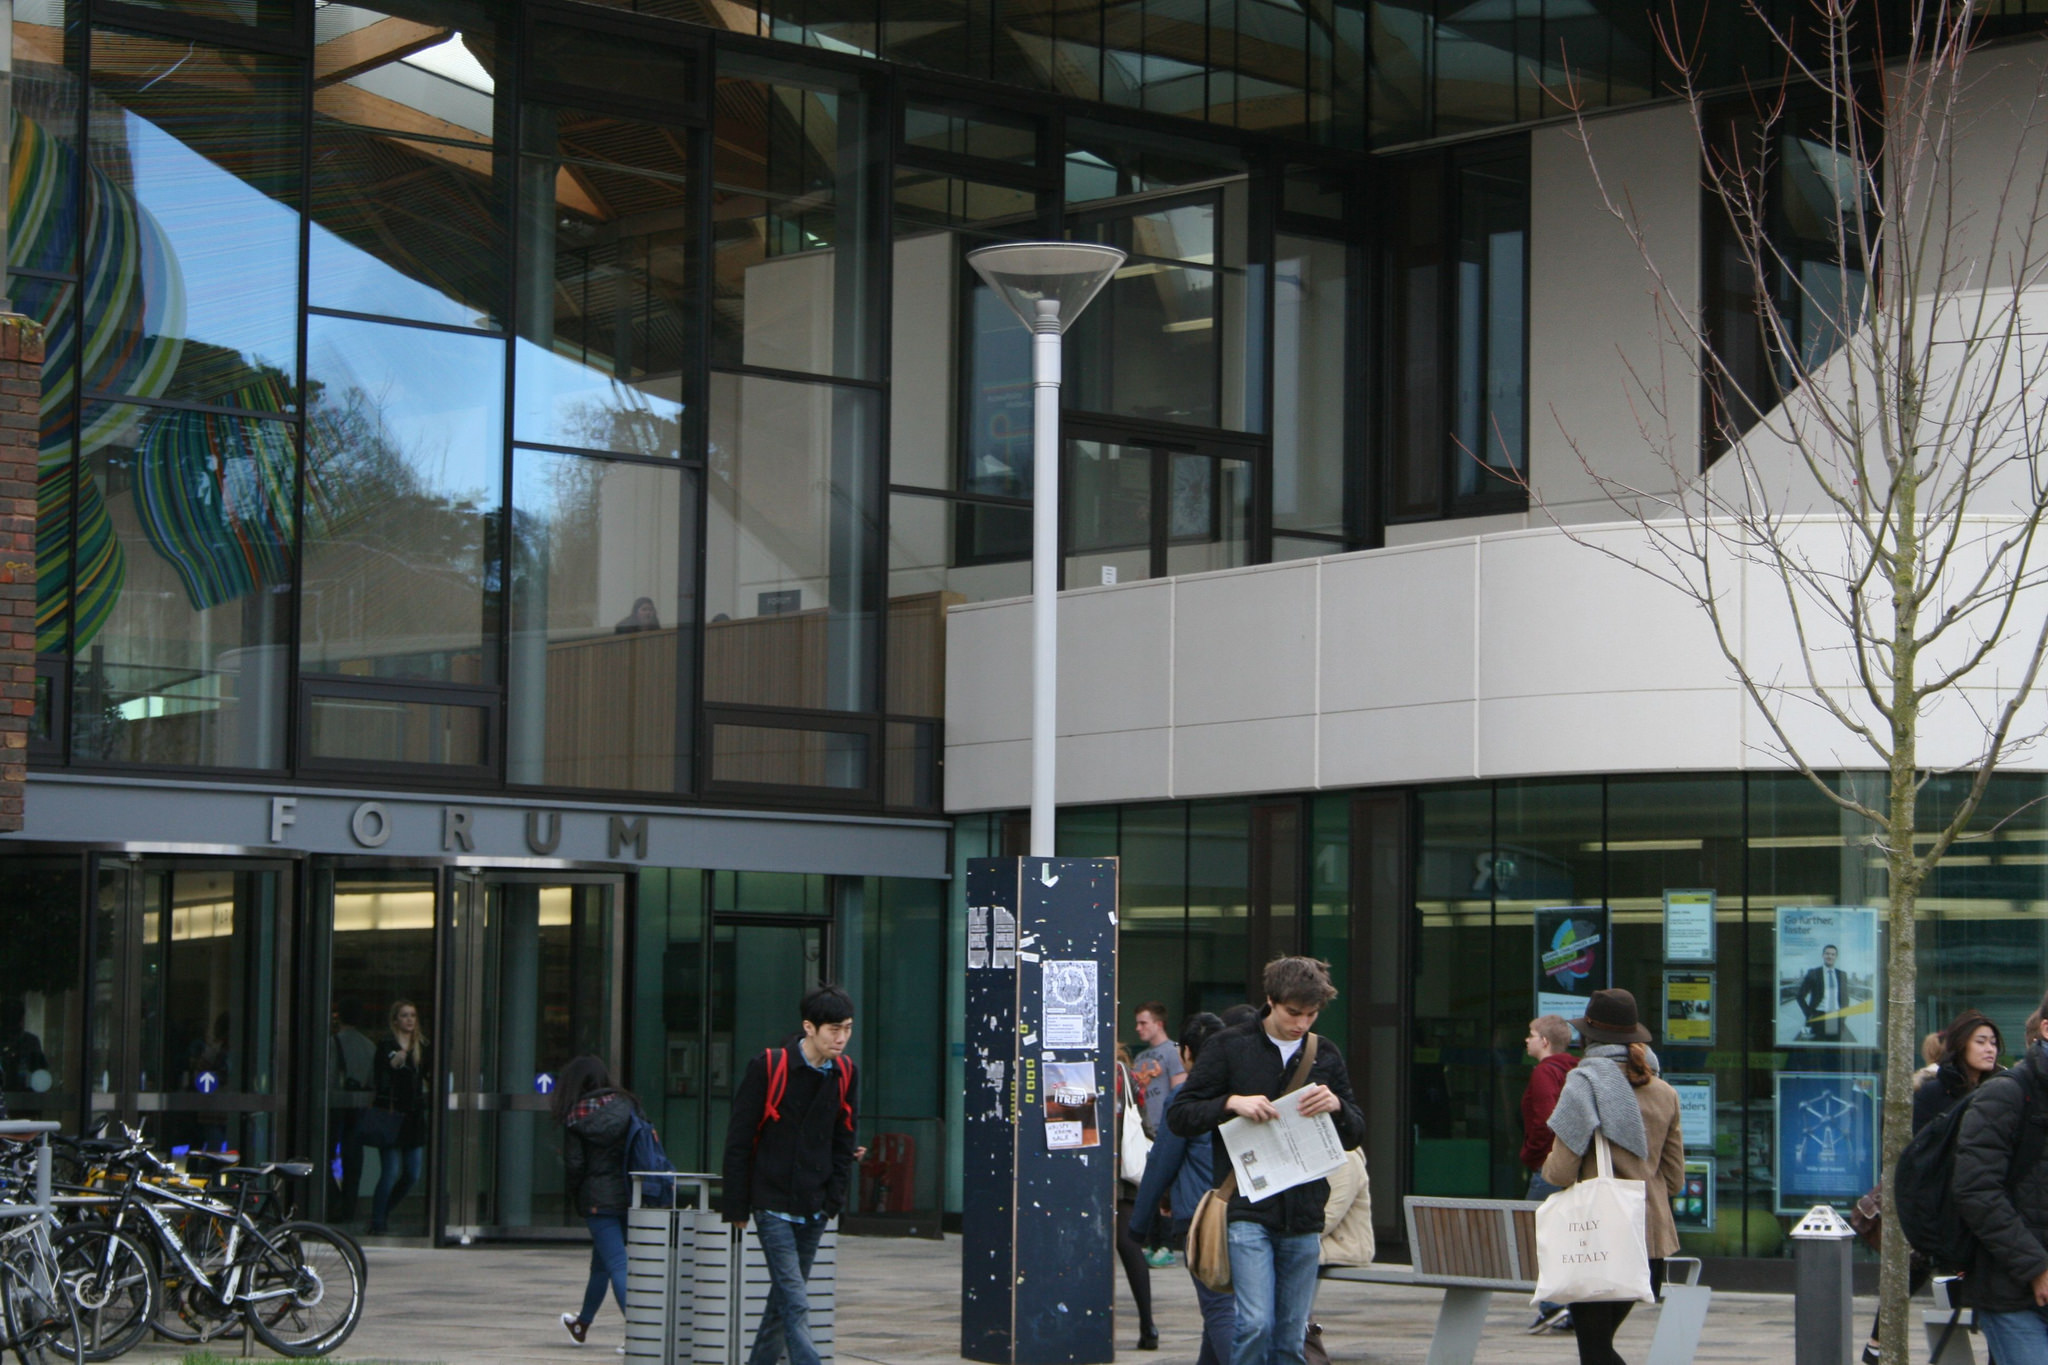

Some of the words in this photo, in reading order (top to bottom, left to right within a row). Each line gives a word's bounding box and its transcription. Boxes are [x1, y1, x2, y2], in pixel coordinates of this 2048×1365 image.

[270, 797, 648, 860] FORUM
[1784, 915, 1797, 925] Go
[1800, 915, 1834, 926] further,
[1784, 926, 1811, 935] faster
[1058, 1094, 1085, 1105] TREK
[1680, 1101, 1706, 1110] aders
[1568, 1220, 1600, 1233] ITALY
[1561, 1251, 1609, 1264] EATALY
